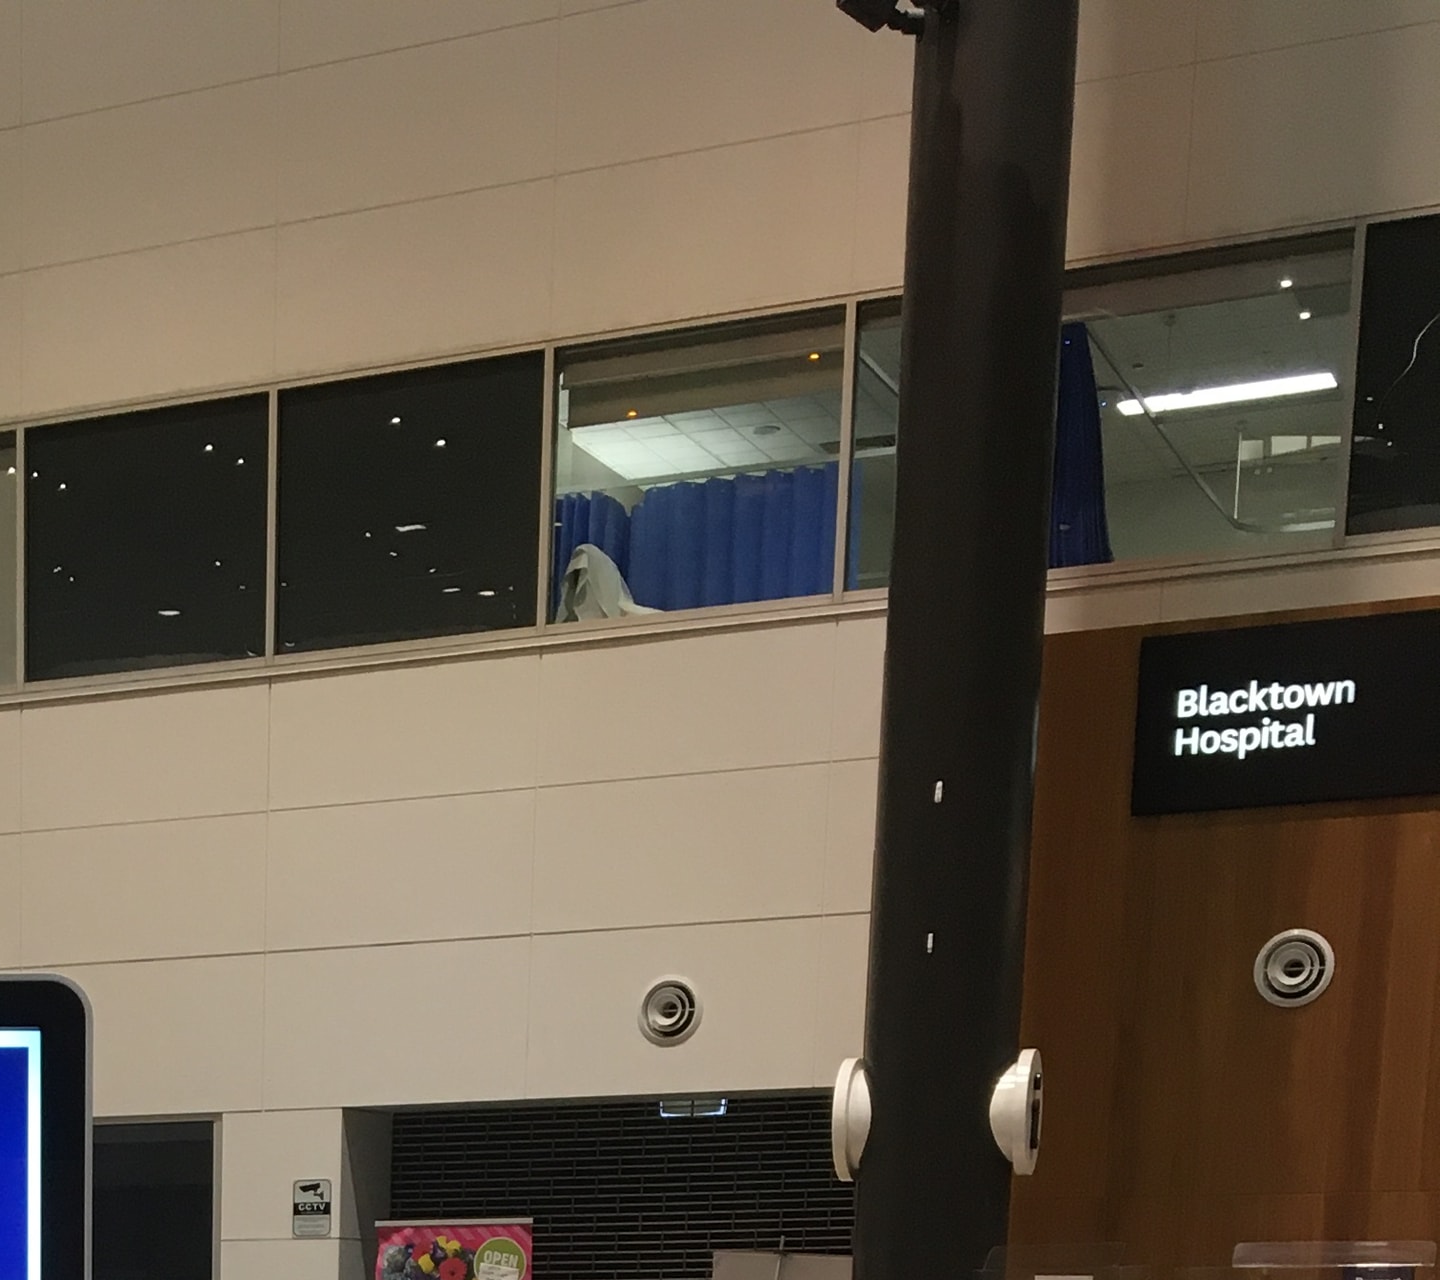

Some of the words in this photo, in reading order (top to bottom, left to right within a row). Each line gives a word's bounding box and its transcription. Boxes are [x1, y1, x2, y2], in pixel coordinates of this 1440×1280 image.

[1177, 680, 1356, 718] Blacktown
[1175, 713, 1316, 760] Hospital
[298, 1203, 326, 1211] CCTV
[483, 1250, 519, 1268] OPEN
